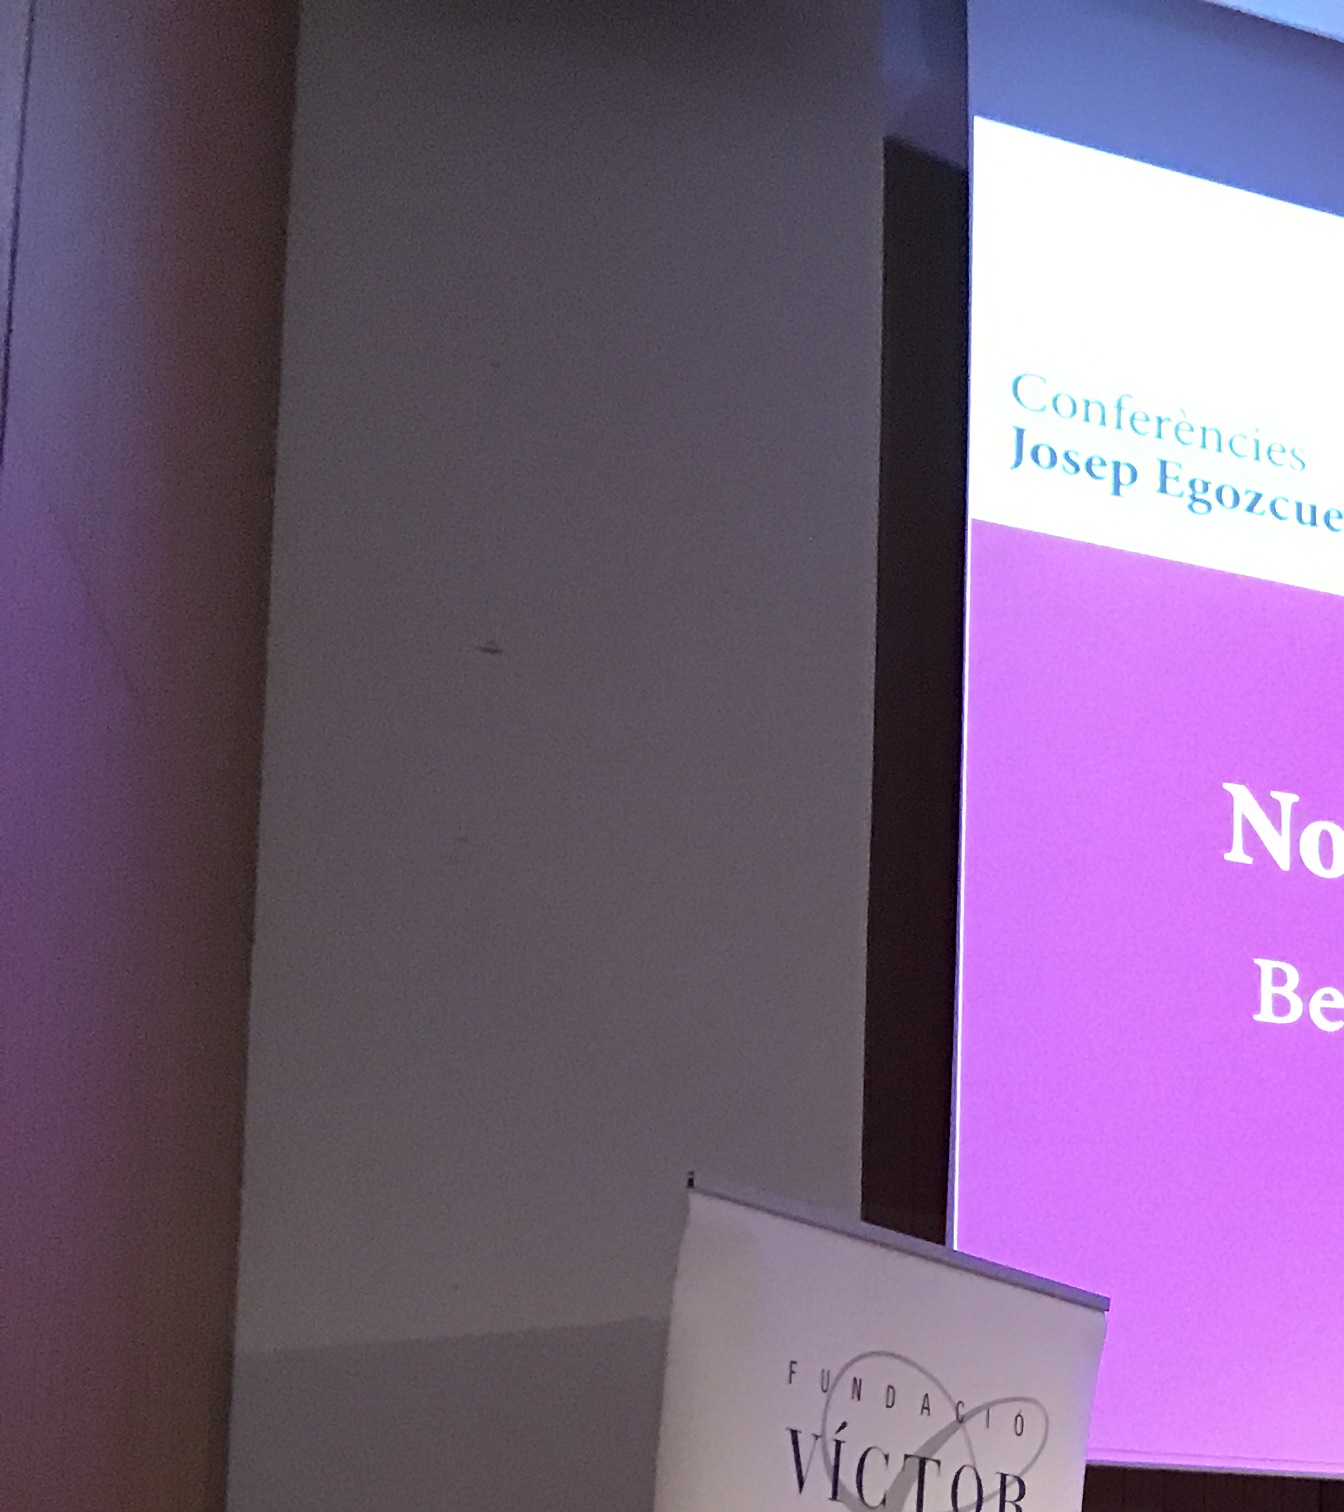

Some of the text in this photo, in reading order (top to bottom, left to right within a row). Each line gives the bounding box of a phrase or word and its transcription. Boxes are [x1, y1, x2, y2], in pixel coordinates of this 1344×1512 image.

[1011, 373, 1306, 472] Conferències
[1010, 425, 1344, 533] Josep Egozcue
[787, 1360, 1024, 1436] FUNDACIÓ
